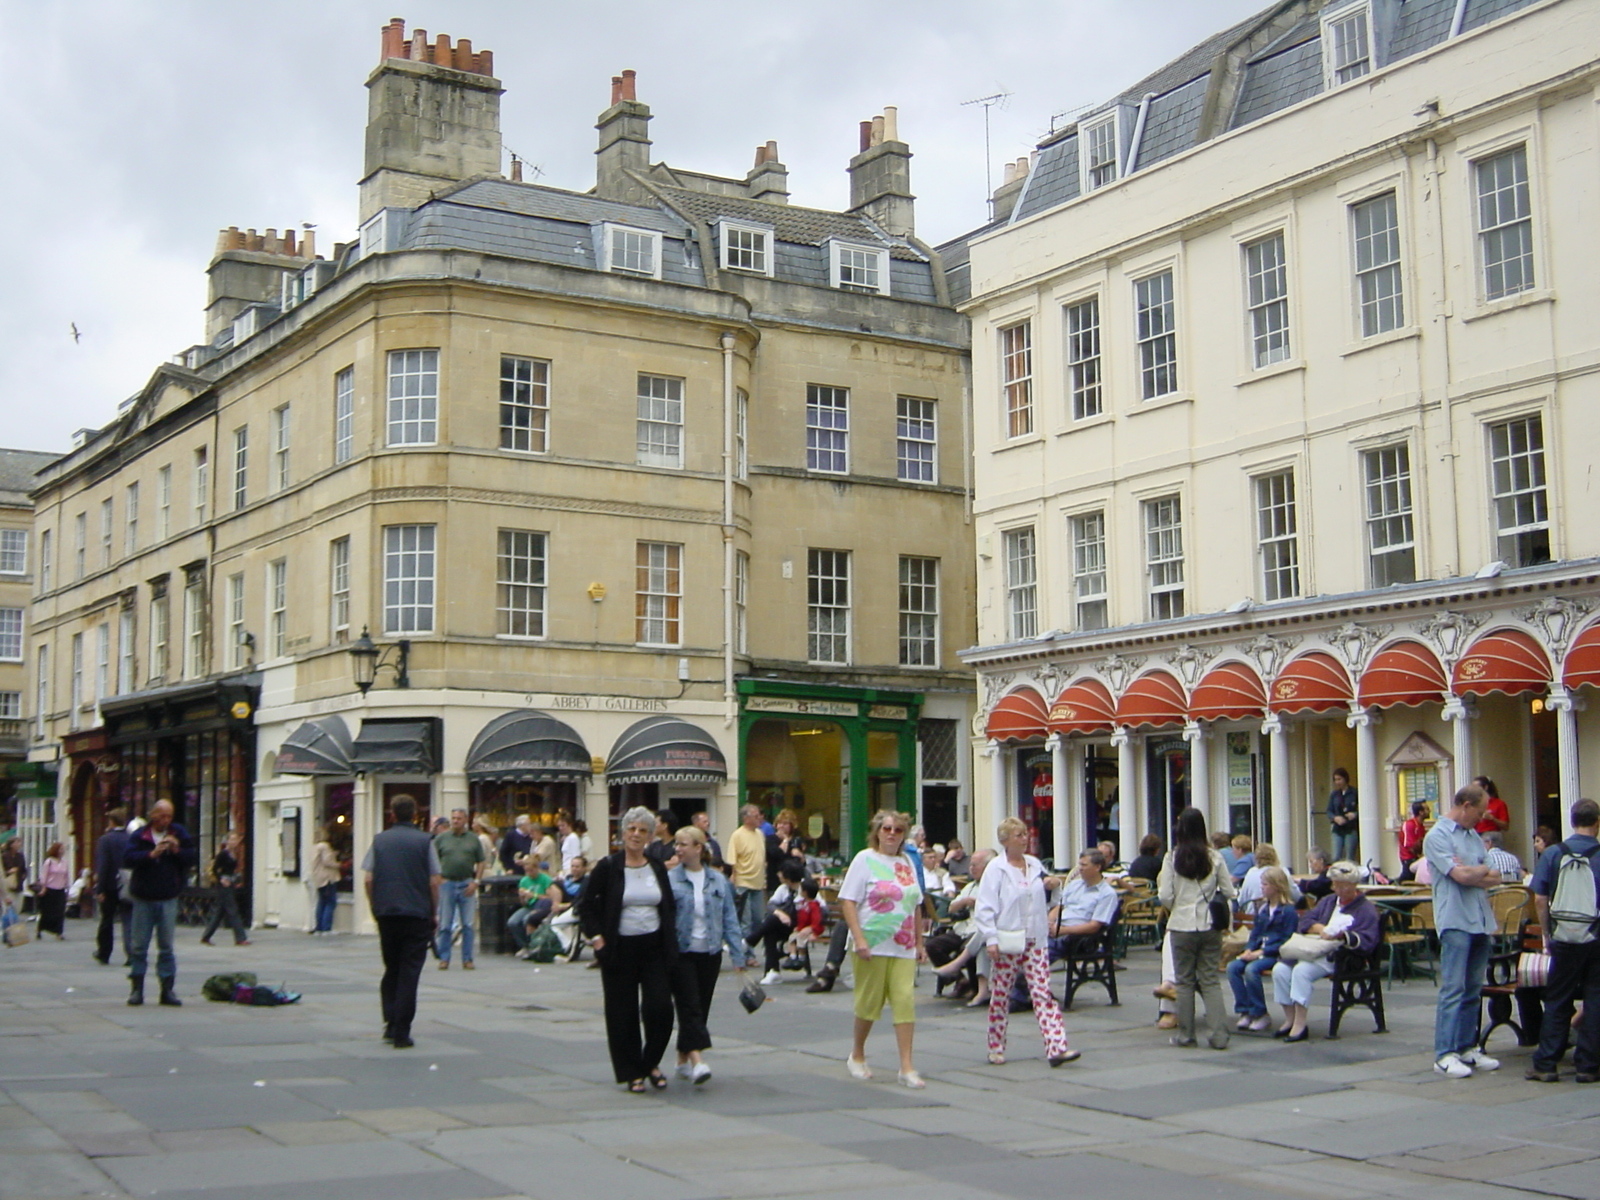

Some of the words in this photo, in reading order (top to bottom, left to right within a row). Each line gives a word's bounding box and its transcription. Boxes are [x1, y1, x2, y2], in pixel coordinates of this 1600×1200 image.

[525, 695, 533, 706] 9
[551, 697, 592, 709] ABBEY
[605, 699, 668, 711] GALLERIES
